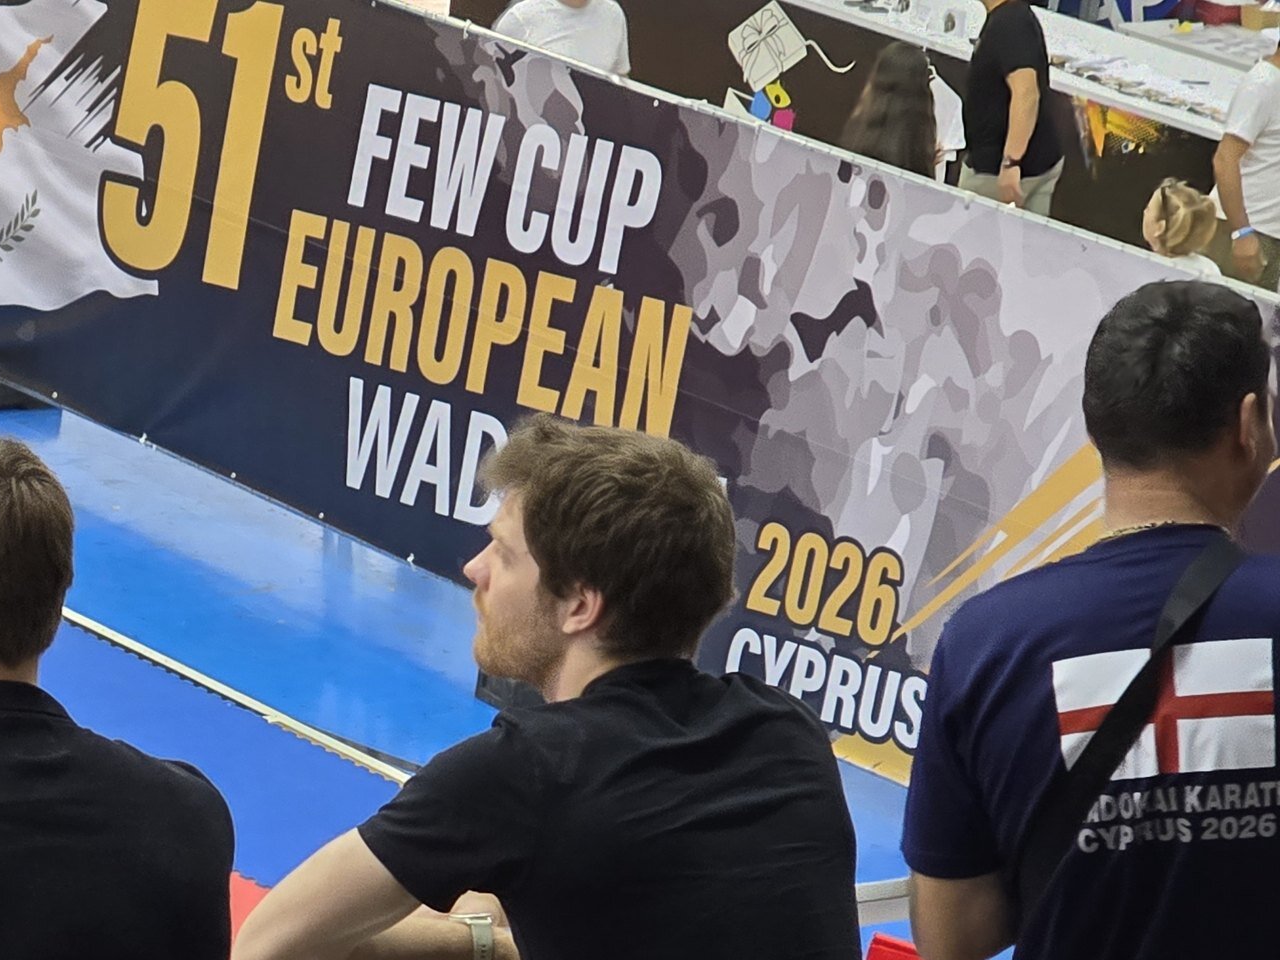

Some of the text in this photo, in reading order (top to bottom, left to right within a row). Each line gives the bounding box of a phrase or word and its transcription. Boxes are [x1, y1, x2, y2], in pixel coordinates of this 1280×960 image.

[347, 83, 663, 275] FEW CUP
[272, 208, 694, 441] EUROPEAN
[746, 521, 902, 646] 2026
[725, 627, 929, 749] CYPRUS
[1077, 813, 1277, 853] CYPRUS 2026
[1082, 780, 1280, 824] ADOKAI KARAT
